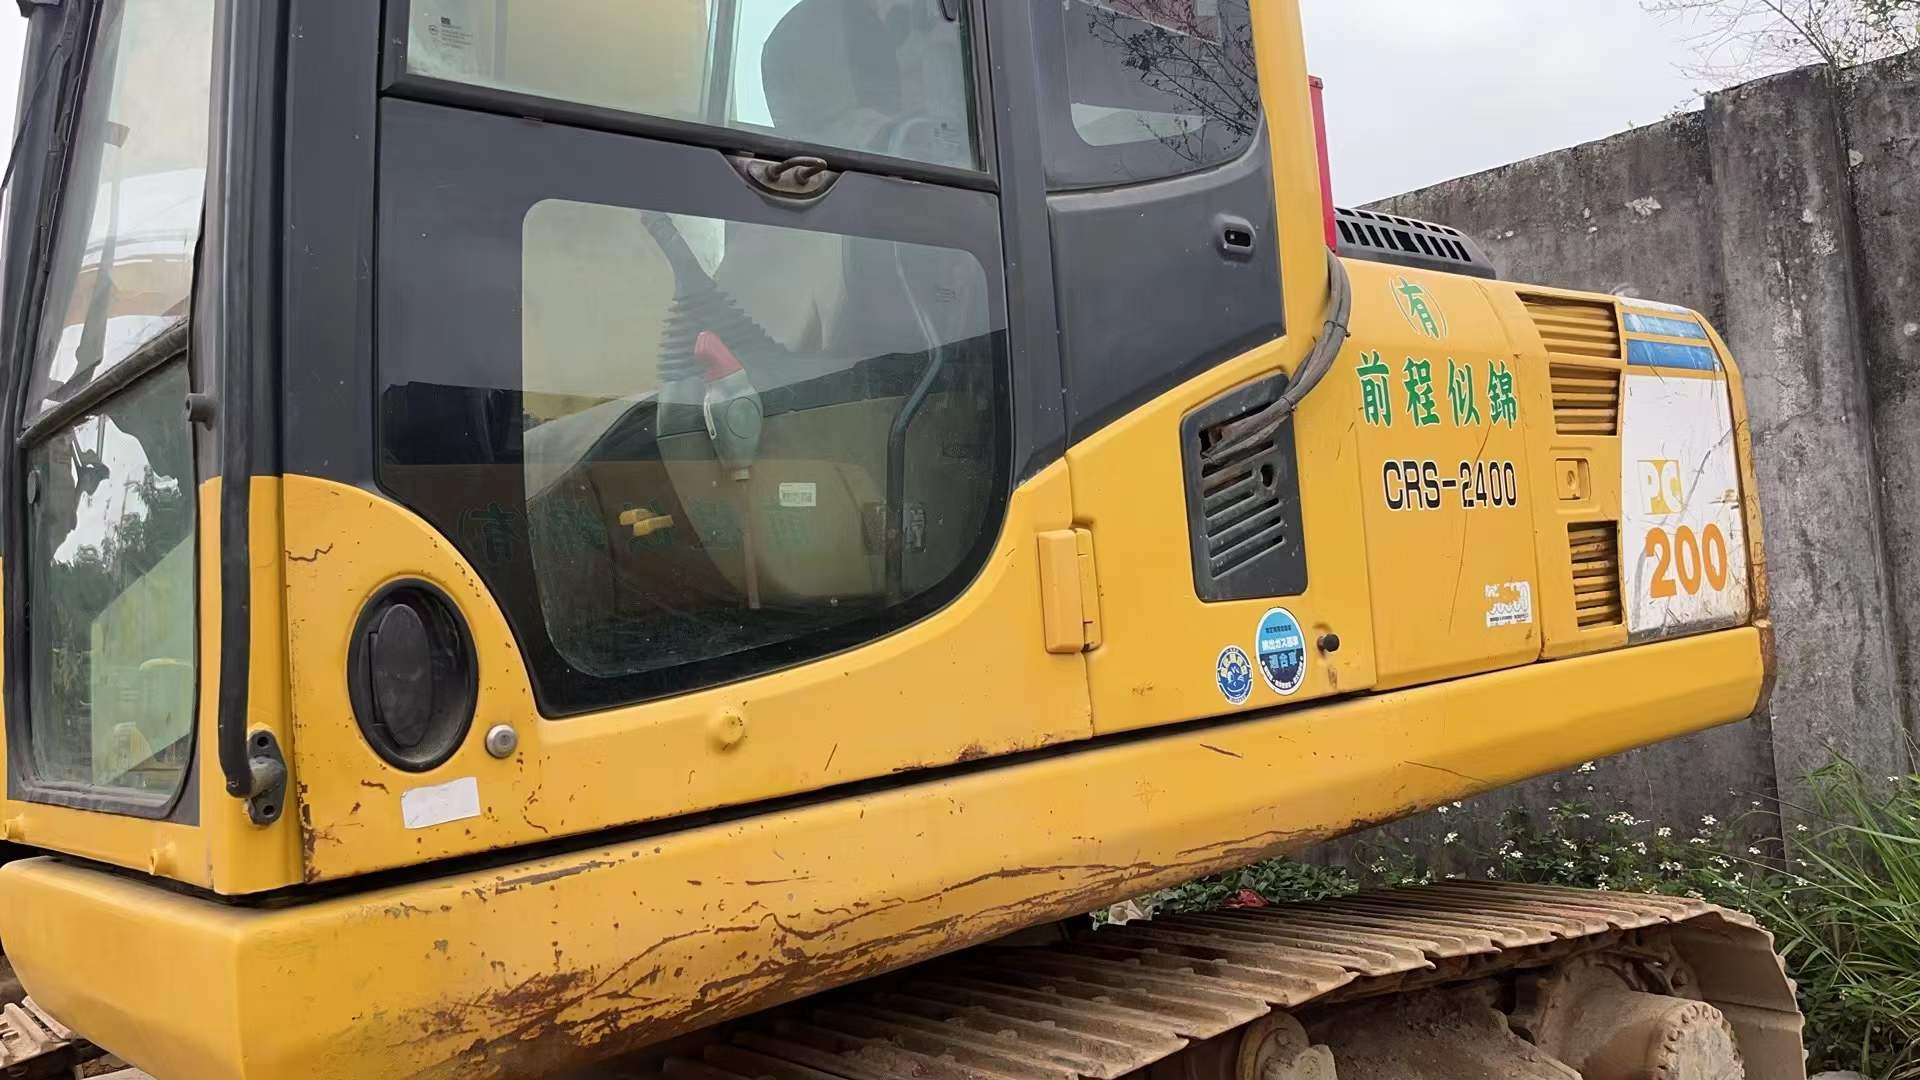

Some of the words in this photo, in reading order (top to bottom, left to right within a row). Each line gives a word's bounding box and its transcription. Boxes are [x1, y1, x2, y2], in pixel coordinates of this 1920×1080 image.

[1356, 350, 1518, 430] 前程似錦
[1383, 459, 1517, 511] CRS-2400
[1638, 460, 1683, 515] PC
[1645, 523, 1728, 599] 200
